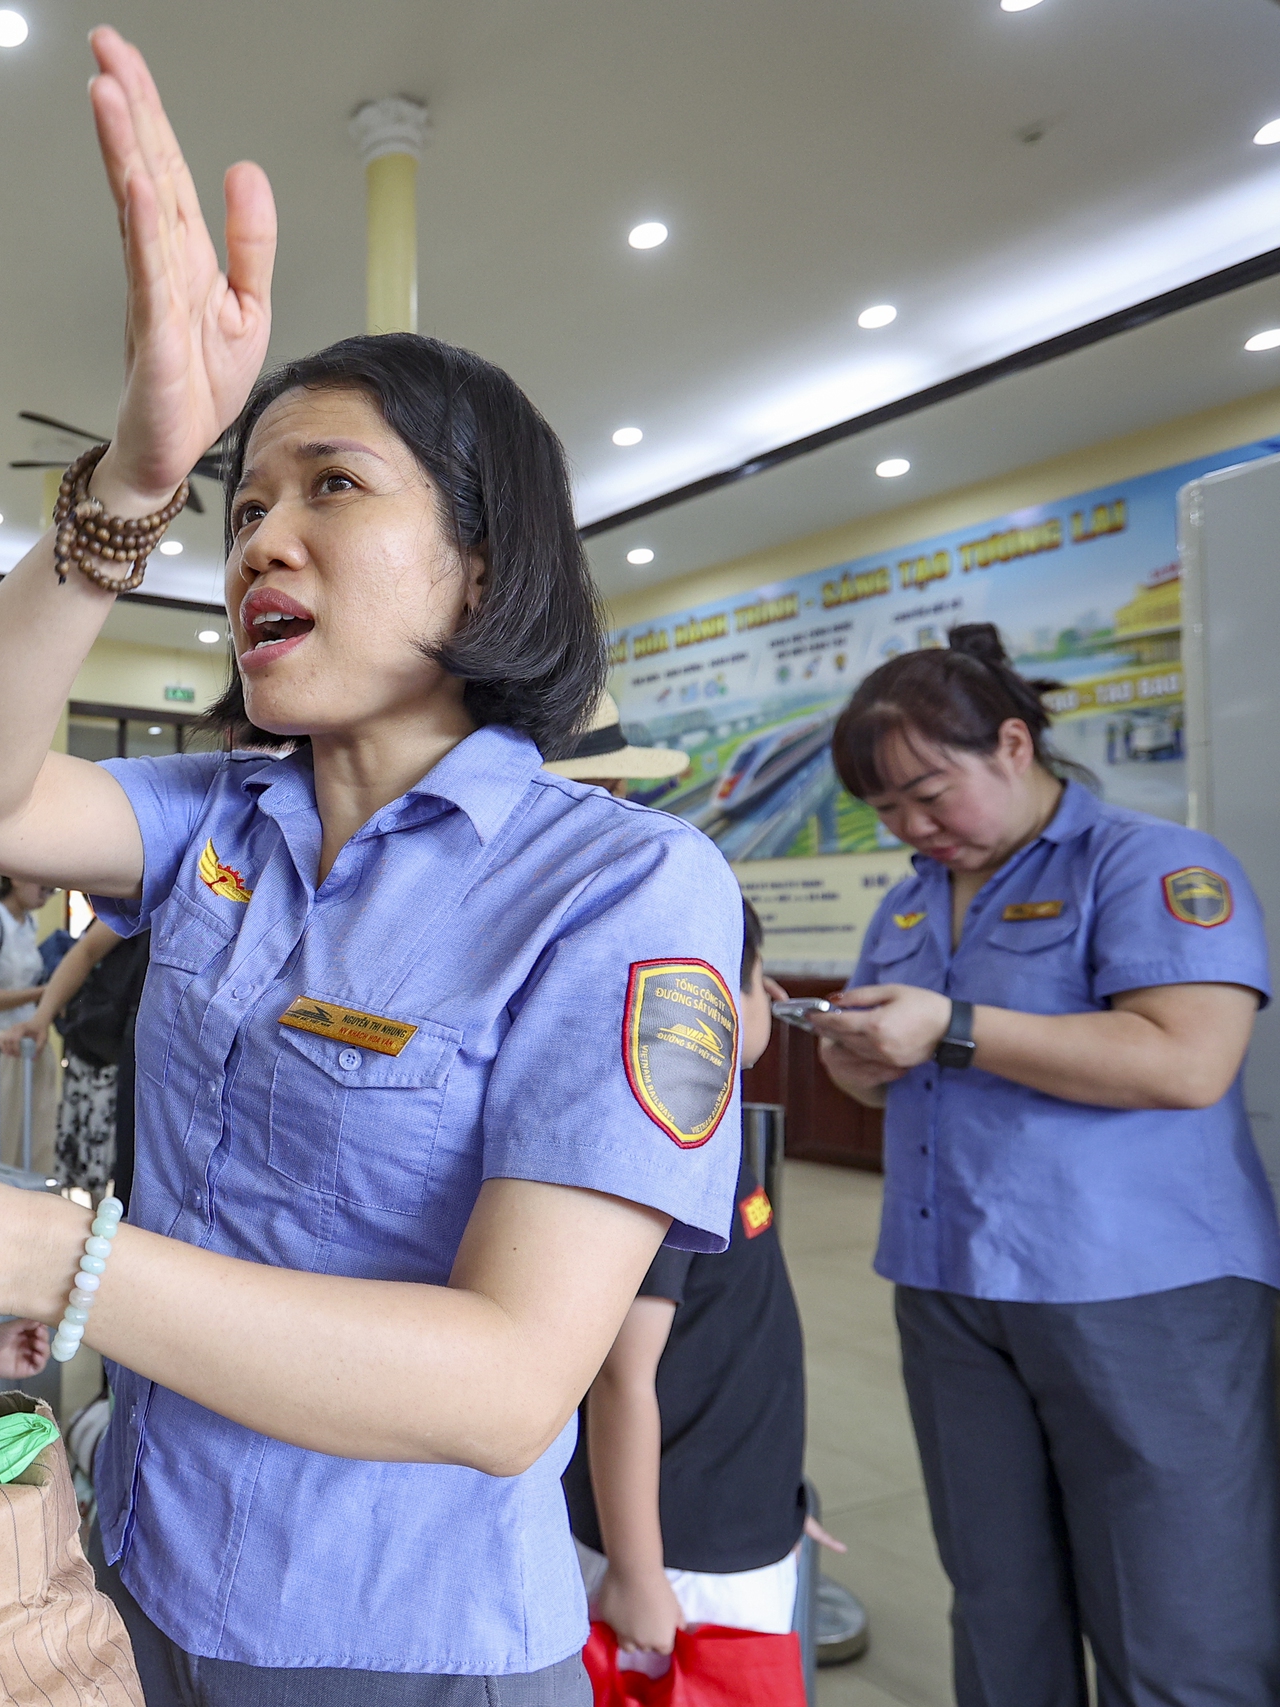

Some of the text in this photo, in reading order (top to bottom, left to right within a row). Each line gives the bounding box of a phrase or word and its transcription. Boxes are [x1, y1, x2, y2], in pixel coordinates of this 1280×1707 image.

[1071, 498, 1127, 544] LAI
[656, 986, 692, 1007] ĐƯỜNG
[693, 997, 708, 1014] SẮT
[707, 1005, 721, 1023] VIỆT
[675, 977, 726, 1012] TỔNG CÔNG TY
[381, 1025, 408, 1038] NHUNG
[656, 1032, 685, 1047] ĐƯỜNG
[685, 1040, 699, 1053] SẮT
[641, 1044, 675, 1122] VIETNAM RAILWAYS
